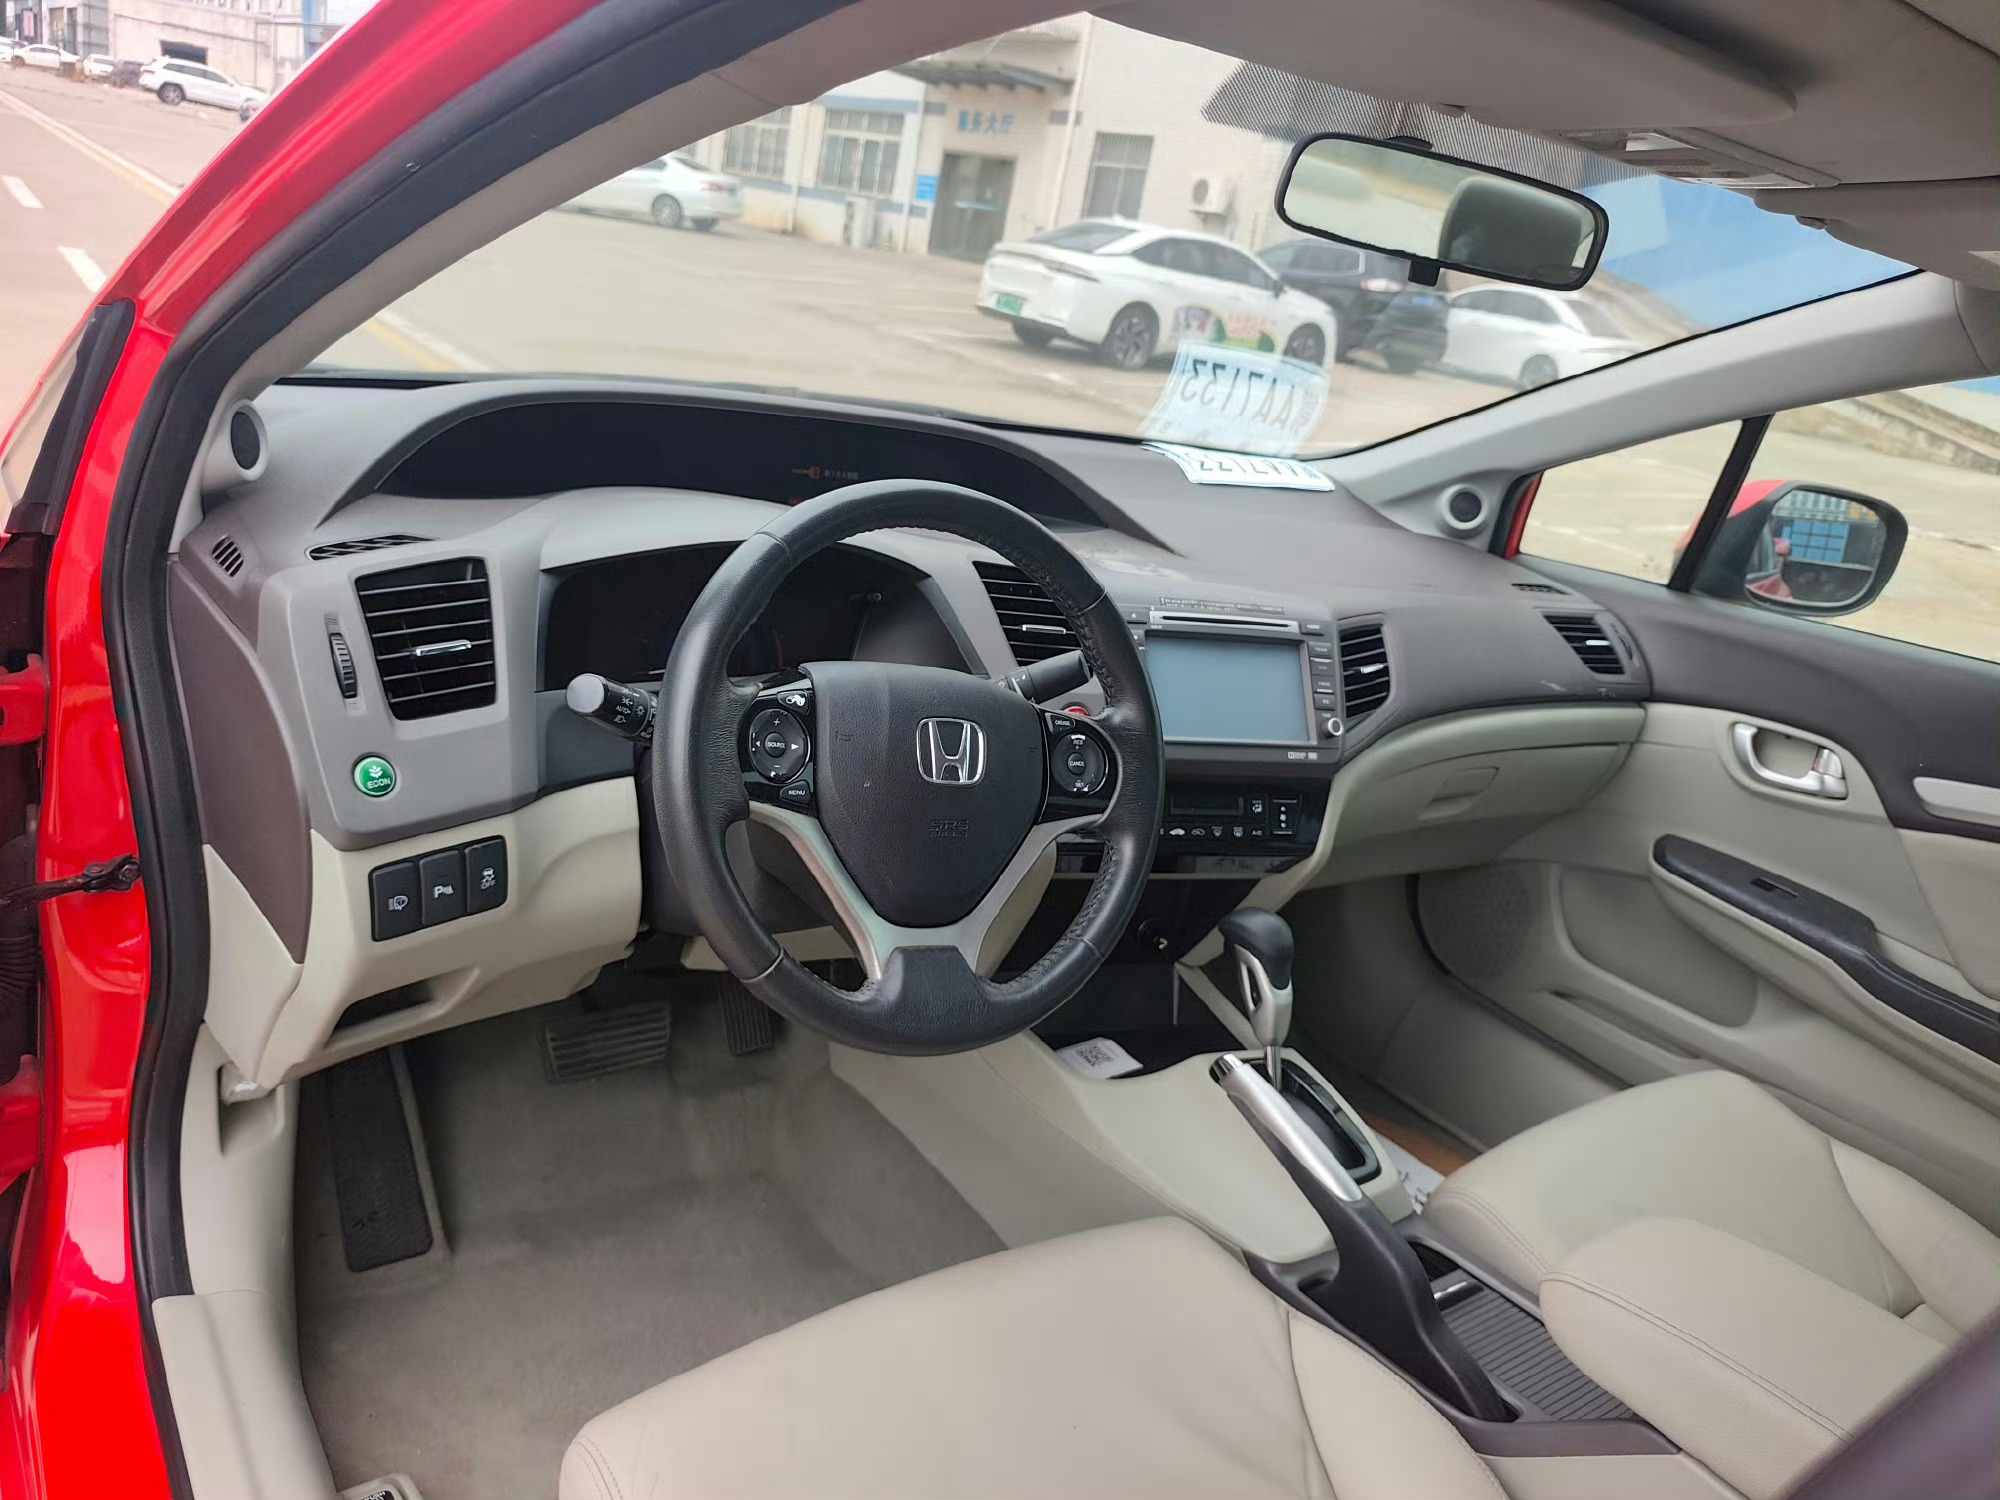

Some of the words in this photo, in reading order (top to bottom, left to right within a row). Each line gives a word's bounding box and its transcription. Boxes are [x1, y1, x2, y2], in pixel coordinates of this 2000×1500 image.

[767, 741, 786, 749] SOURCE
[367, 778, 391, 790] ECON
[931, 819, 969, 830] SRS
[481, 879, 496, 889] OFF
